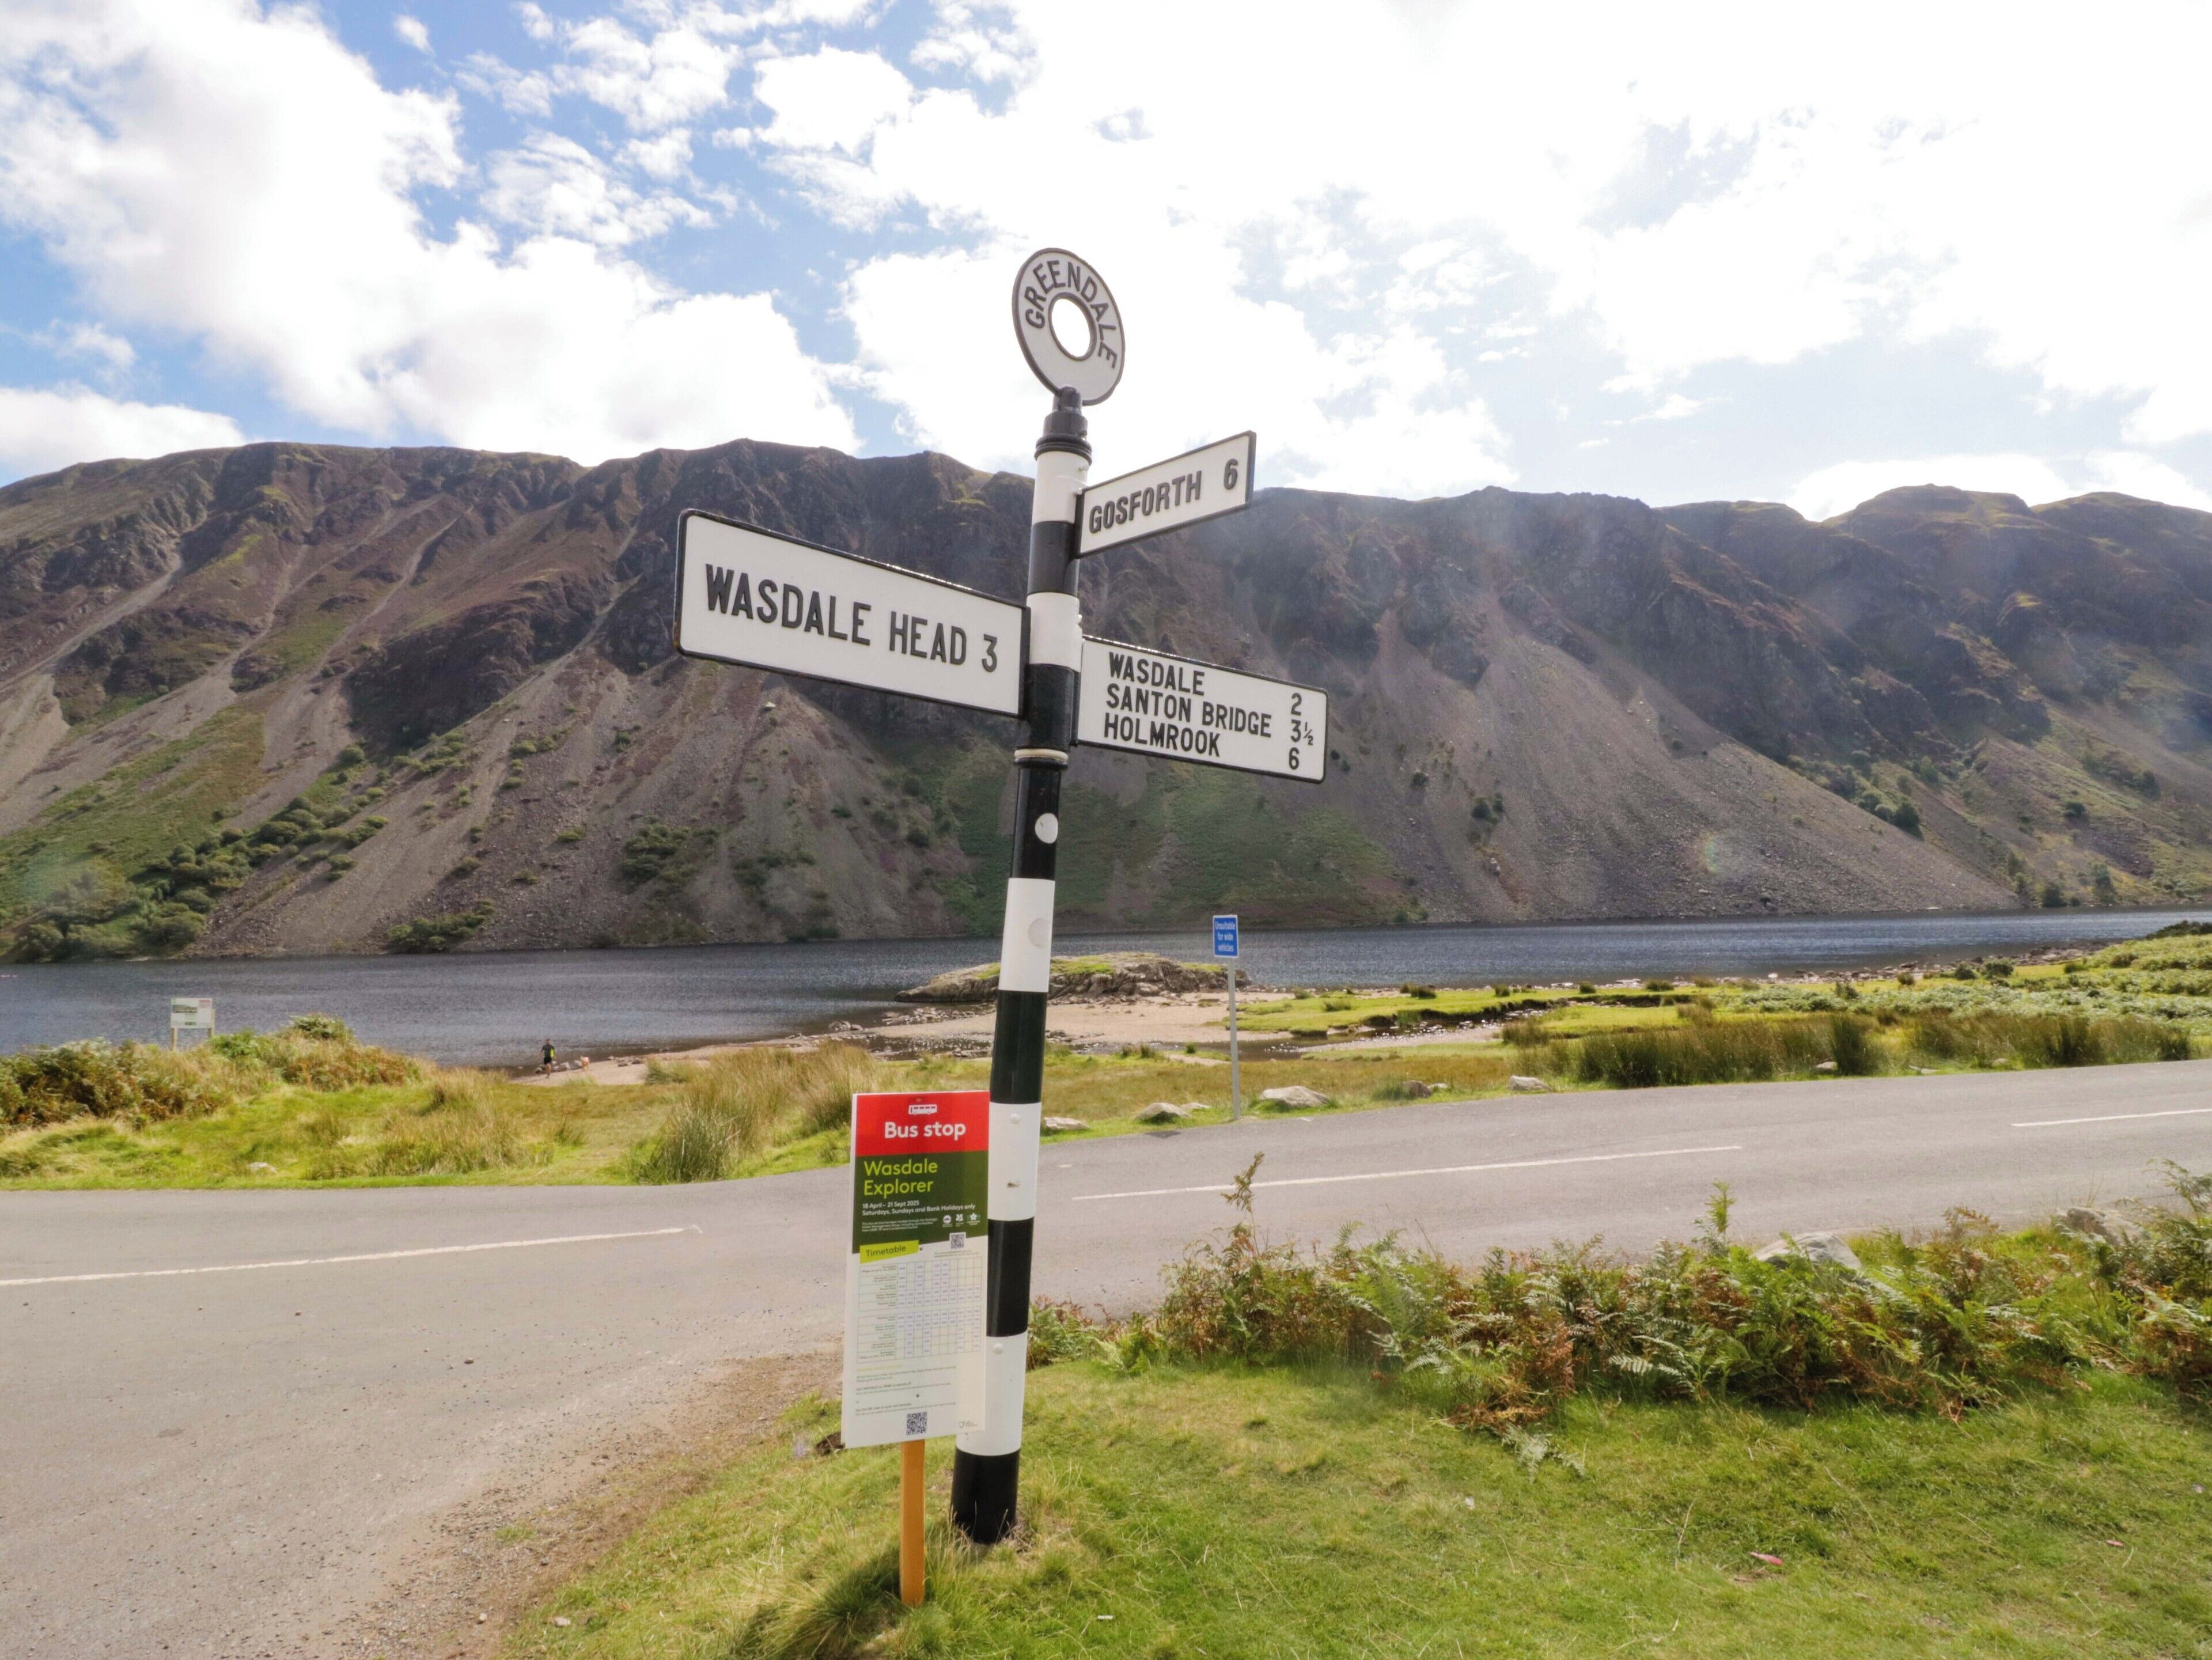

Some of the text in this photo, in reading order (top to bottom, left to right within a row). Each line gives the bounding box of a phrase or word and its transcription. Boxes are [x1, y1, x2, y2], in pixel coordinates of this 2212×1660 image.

[1024, 260, 1118, 369] GREENDALE
[1089, 458, 1238, 534] GOSFORTH 6
[706, 563, 998, 673] WASDALE HEAD 3
[1107, 683, 1191, 723] SANTON
[1202, 702, 1272, 738] BRIDGE
[1109, 651, 1302, 715] WASDALE 2
[1104, 712, 1300, 770] HOLMROOK 6
[884, 1121, 966, 1140] Bus stop
[863, 1158, 938, 1176] Wasdale
[864, 1178, 934, 1199] Explorer
[866, 1245, 907, 1257] Timetable
